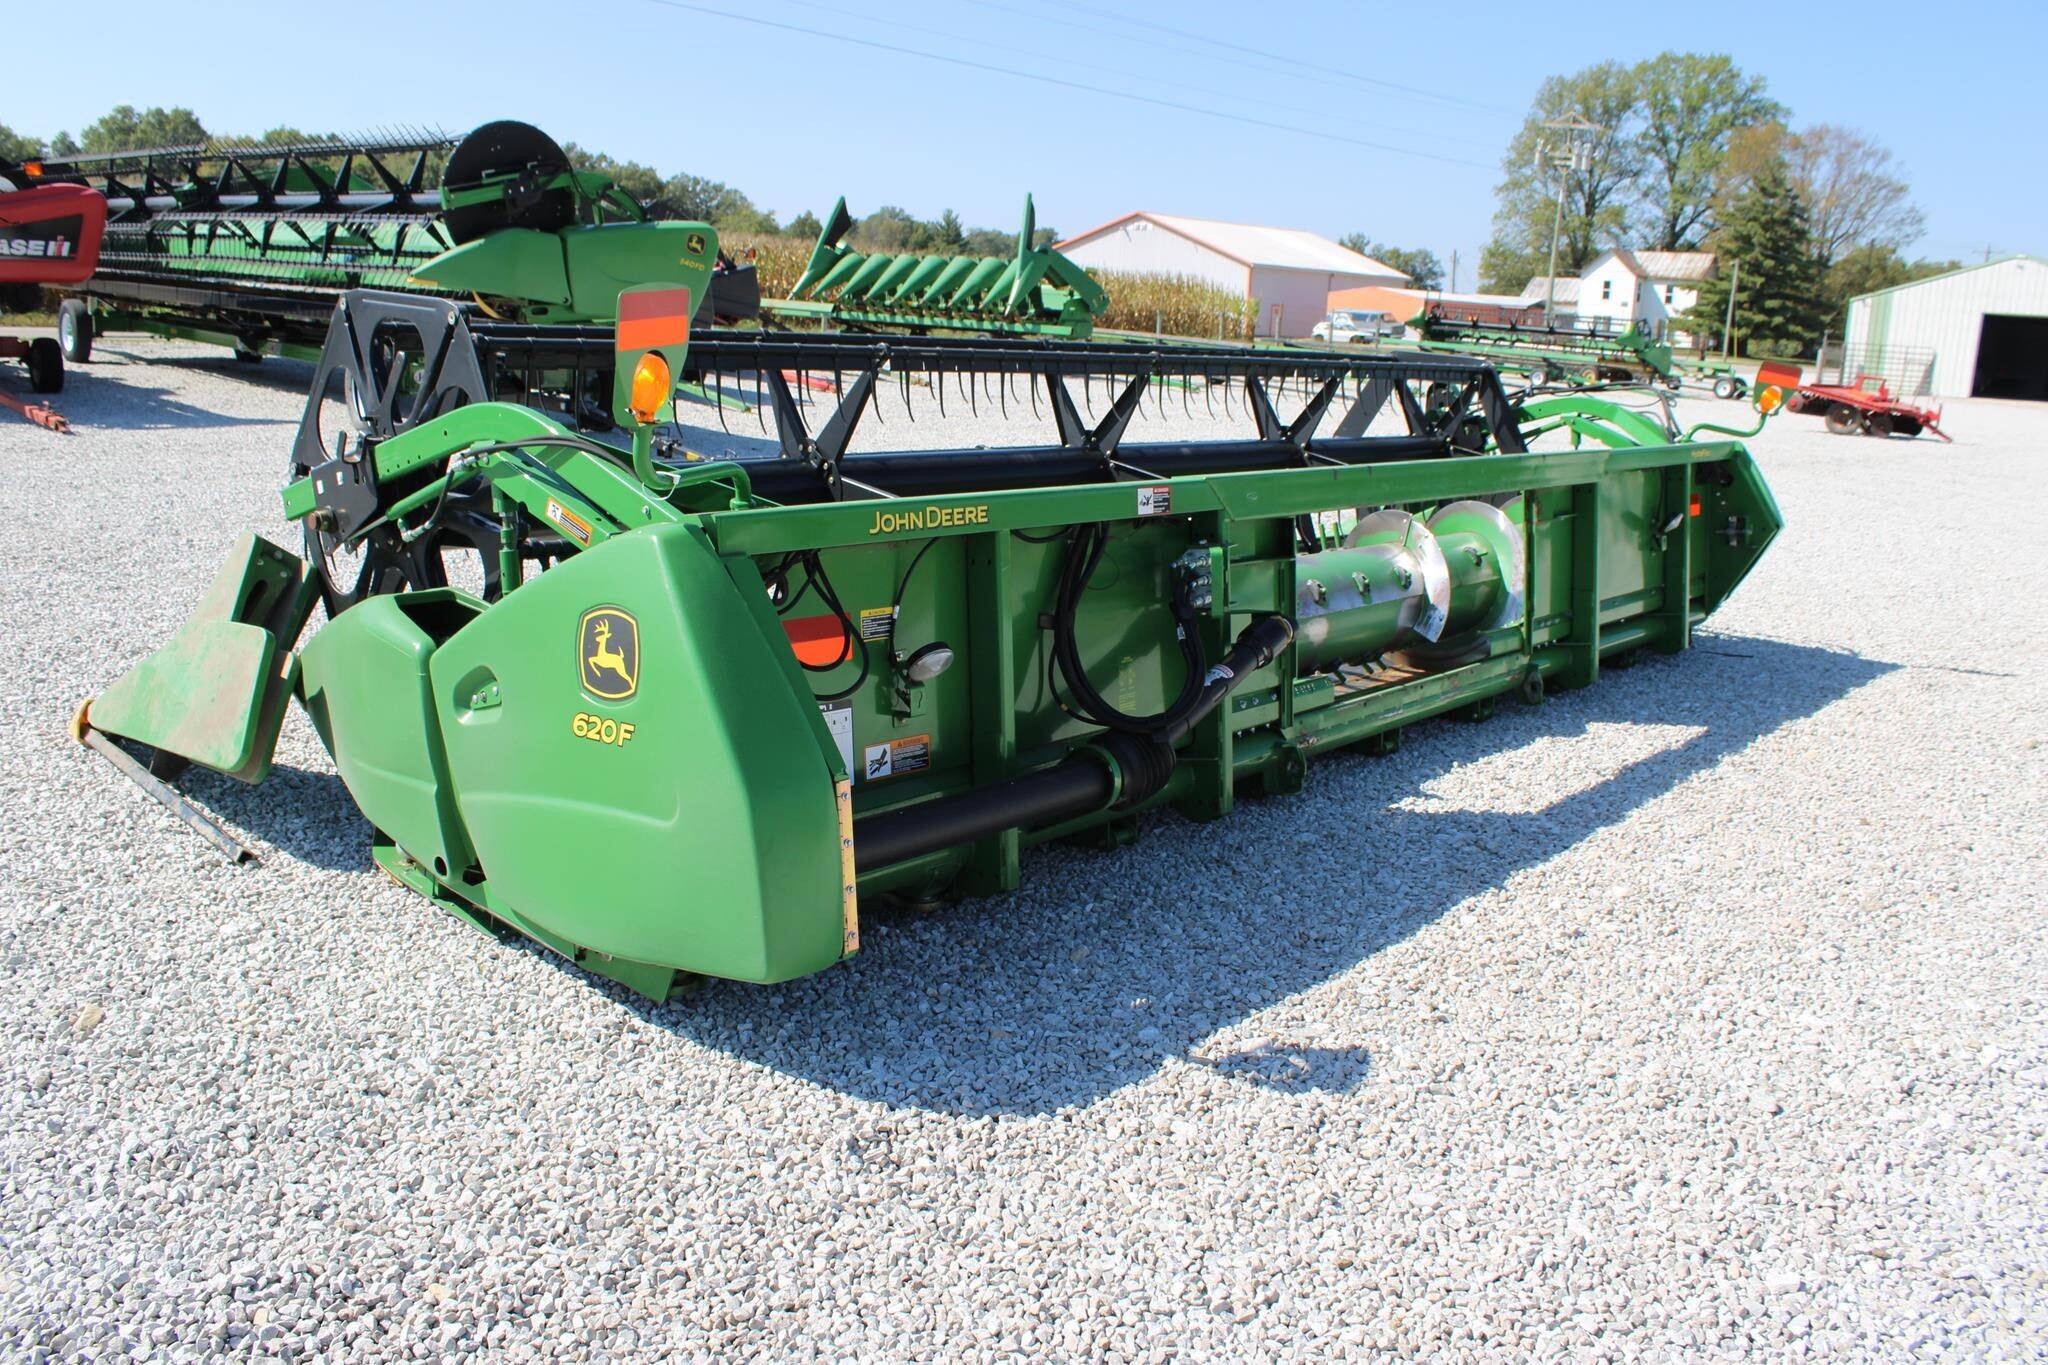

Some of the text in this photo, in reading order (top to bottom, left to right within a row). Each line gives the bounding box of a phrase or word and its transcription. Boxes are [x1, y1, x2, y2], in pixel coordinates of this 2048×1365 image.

[869, 506, 989, 534] JOHN DEERE
[573, 712, 636, 747] 620F
